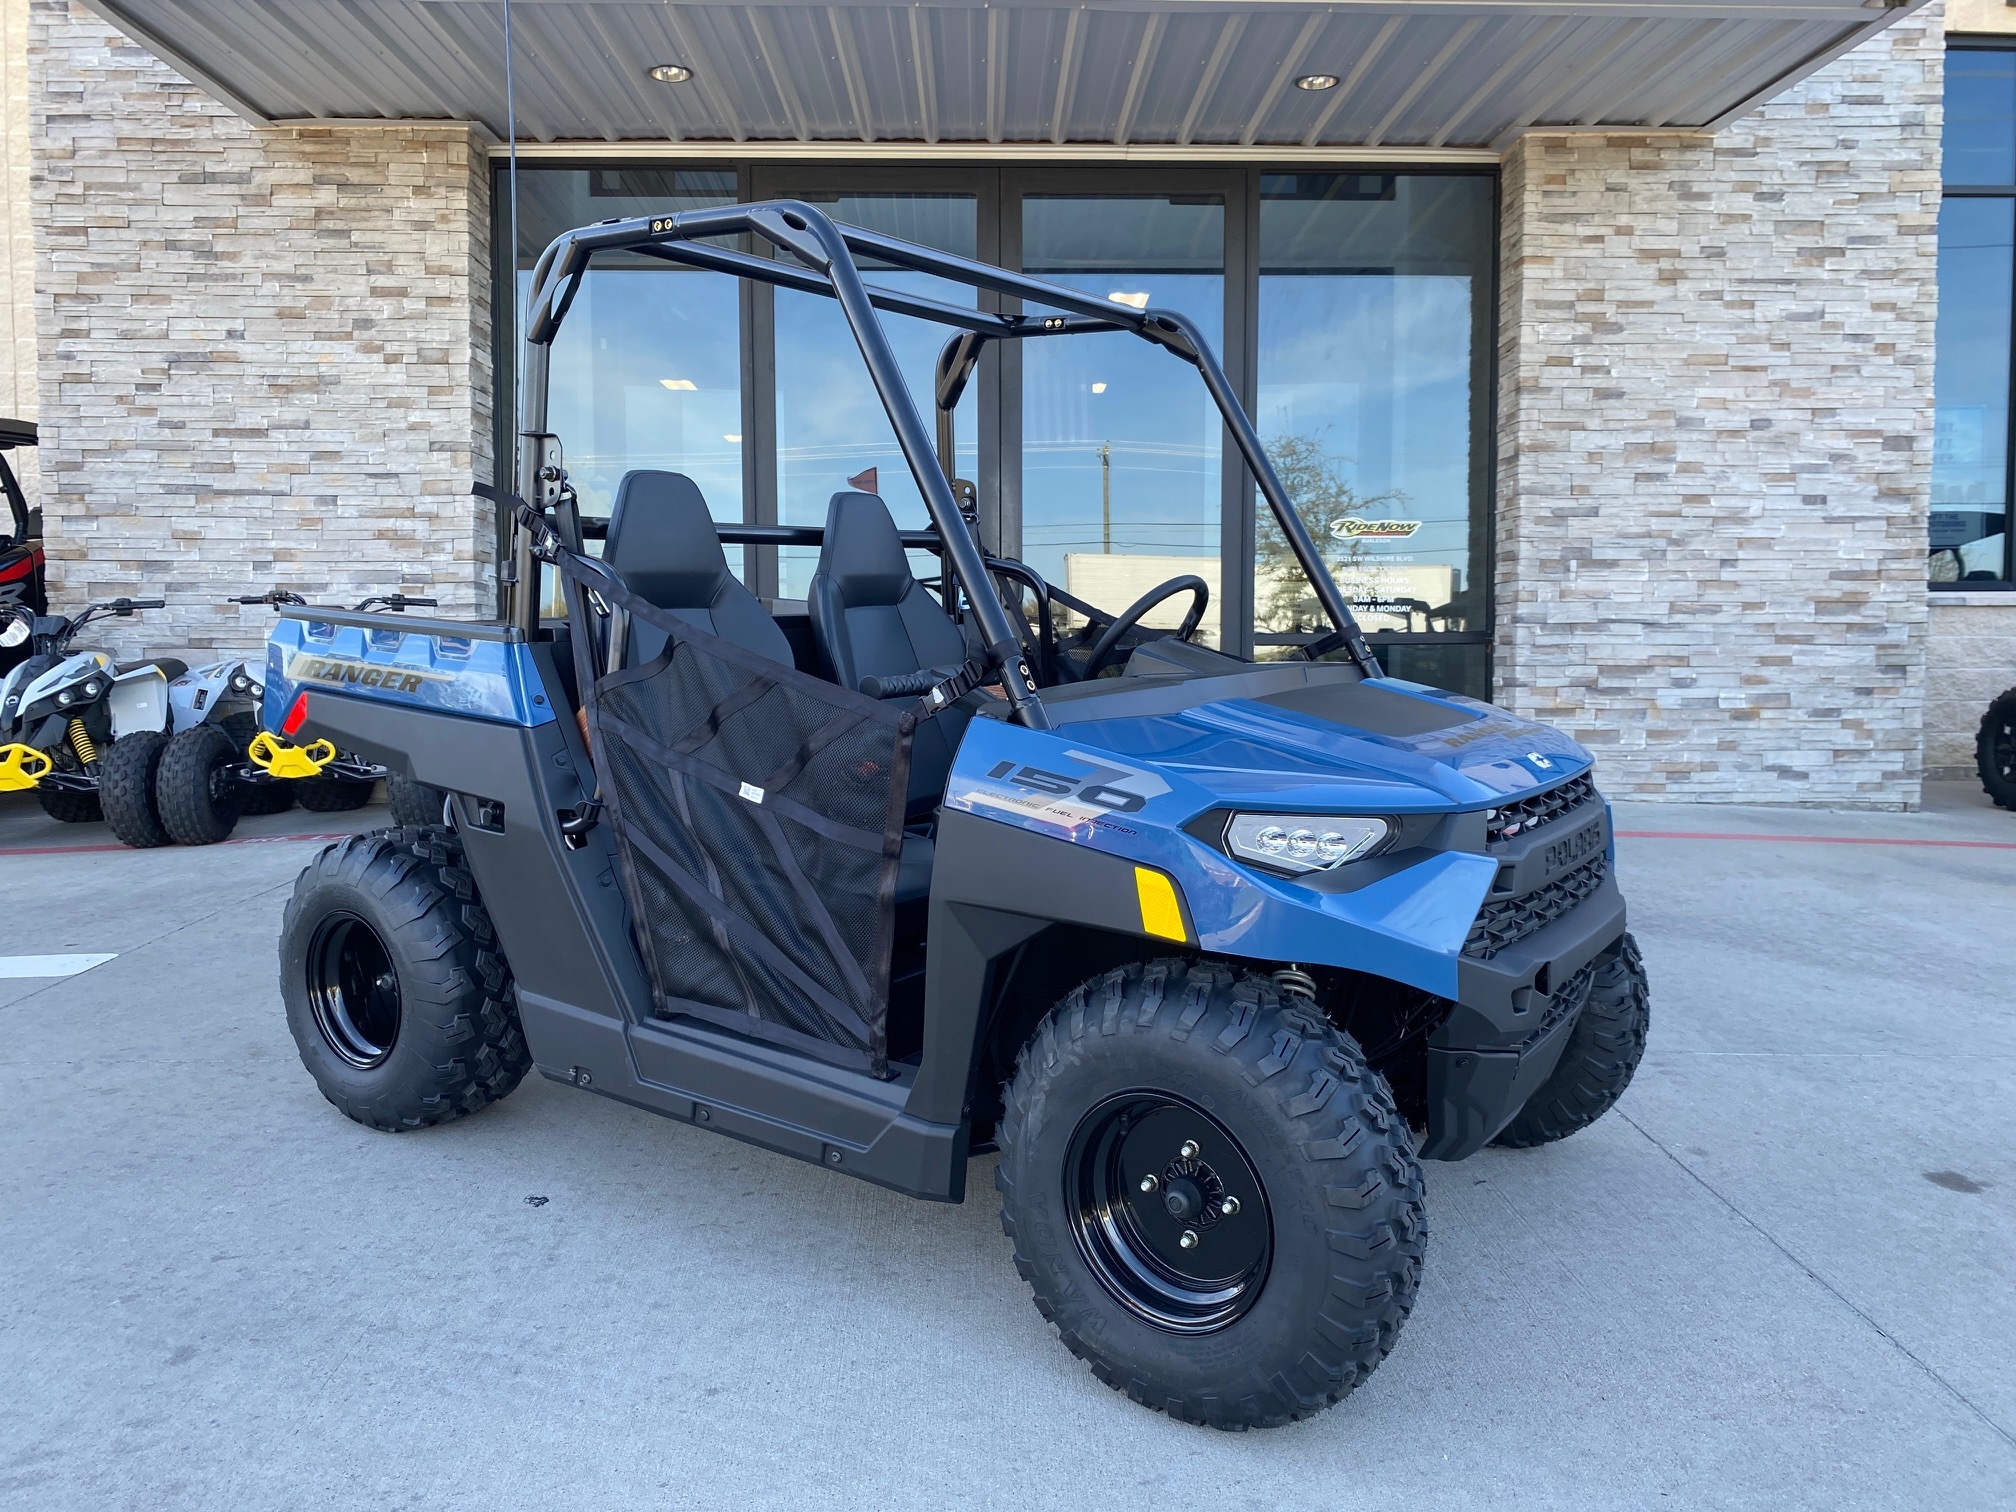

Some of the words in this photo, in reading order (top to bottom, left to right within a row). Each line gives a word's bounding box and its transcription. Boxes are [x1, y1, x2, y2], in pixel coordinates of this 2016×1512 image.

[1357, 614, 1390, 622] CLOSED
[1376, 605, 1412, 613] MONDAY
[303, 659, 423, 693] RANGER
[987, 760, 1147, 813] 150
[975, 788, 1041, 809] ELECTRONIC
[1045, 807, 1074, 818] FUEL
[1545, 821, 1600, 876] POLARIS
